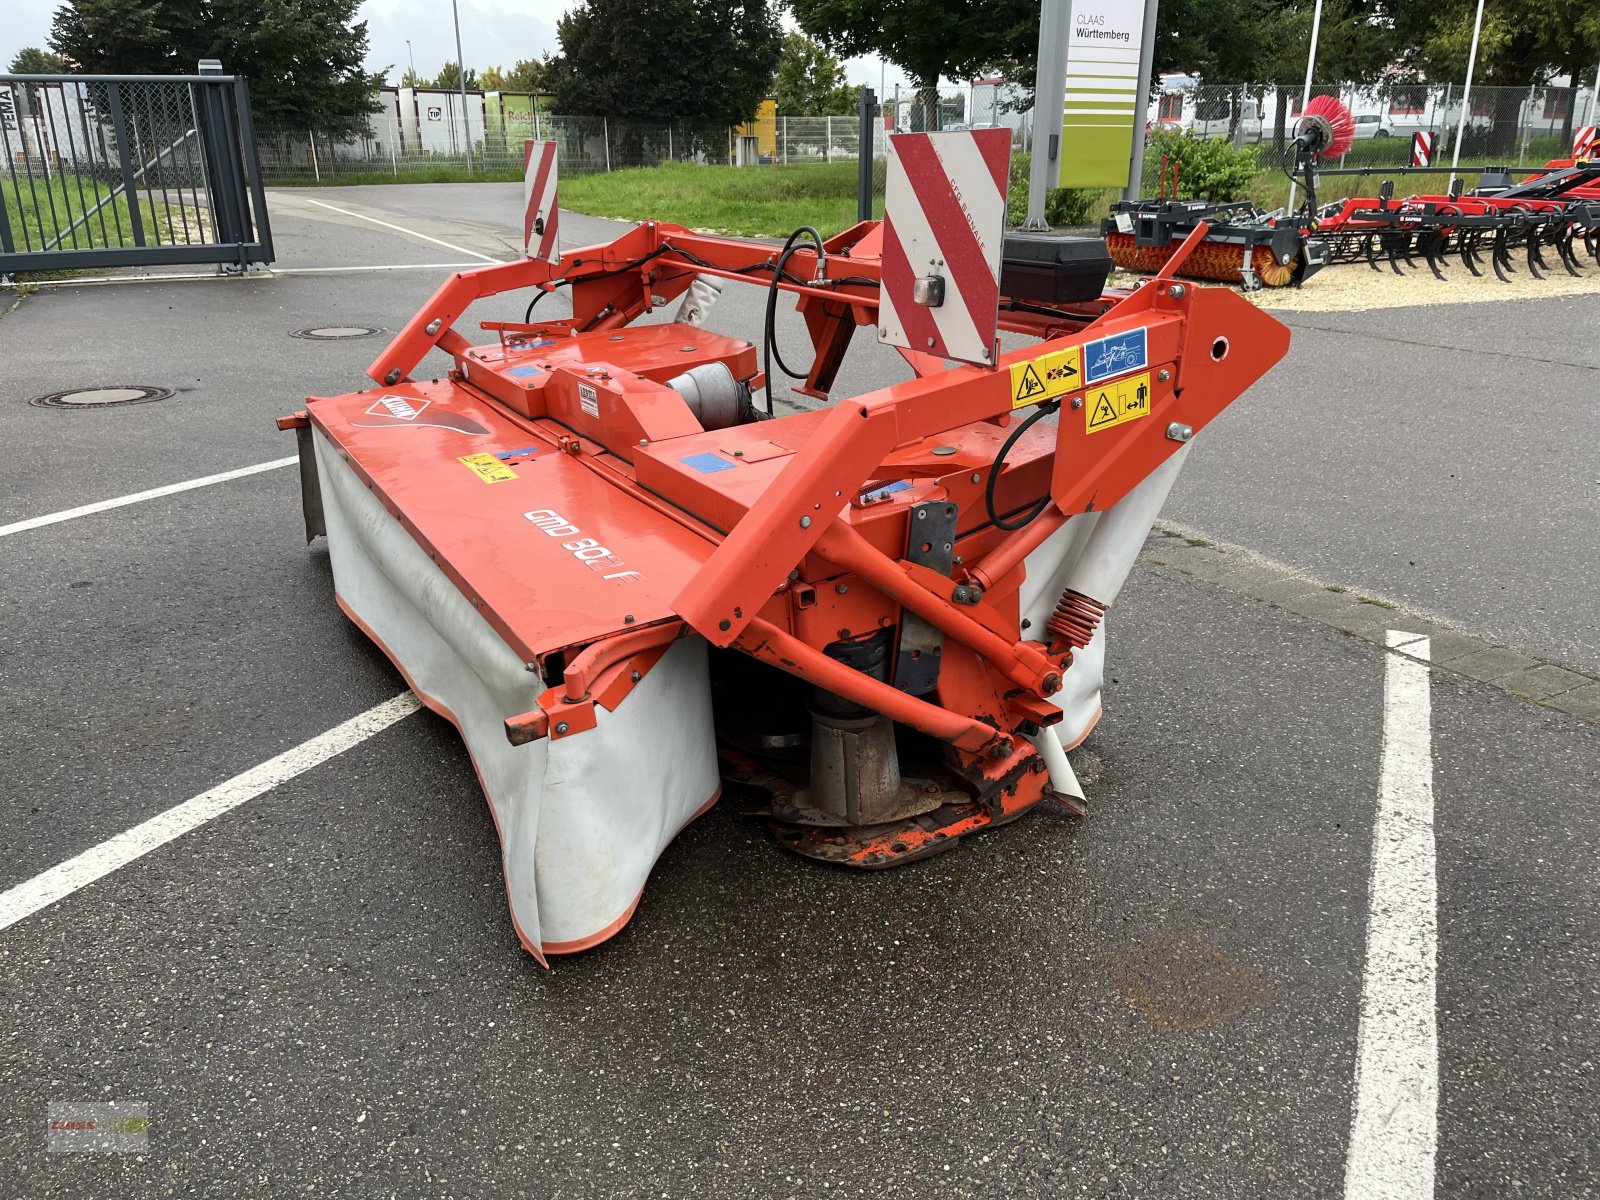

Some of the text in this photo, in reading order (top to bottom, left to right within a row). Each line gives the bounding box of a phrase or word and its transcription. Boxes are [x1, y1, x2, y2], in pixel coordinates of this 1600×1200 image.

[1077, 14, 1105, 26] CLAAS
[1076, 27, 1130, 42] Württemberg
[0, 90, 17, 131] PEMA
[523, 509, 580, 537] GMD
